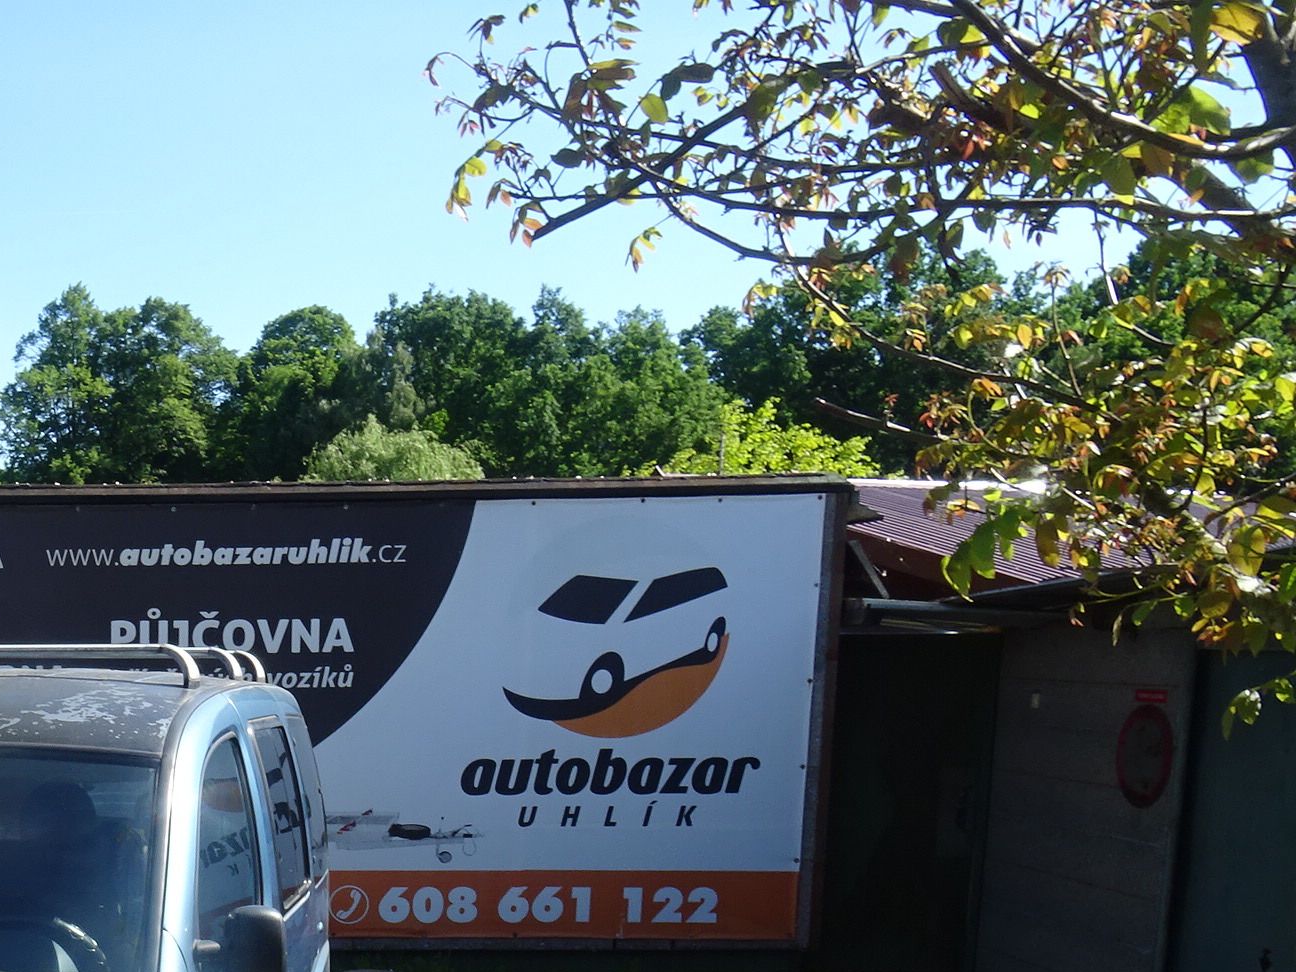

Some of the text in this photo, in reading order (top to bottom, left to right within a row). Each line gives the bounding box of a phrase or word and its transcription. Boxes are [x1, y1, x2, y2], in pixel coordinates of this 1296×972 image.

[46, 537, 407, 567] www.autobazaruhlik.cz
[110, 608, 355, 654] PŮJČOVNA
[461, 748, 760, 795] autobazar
[517, 800, 698, 827] UHLÍK
[378, 886, 718, 923] 608 661 122
